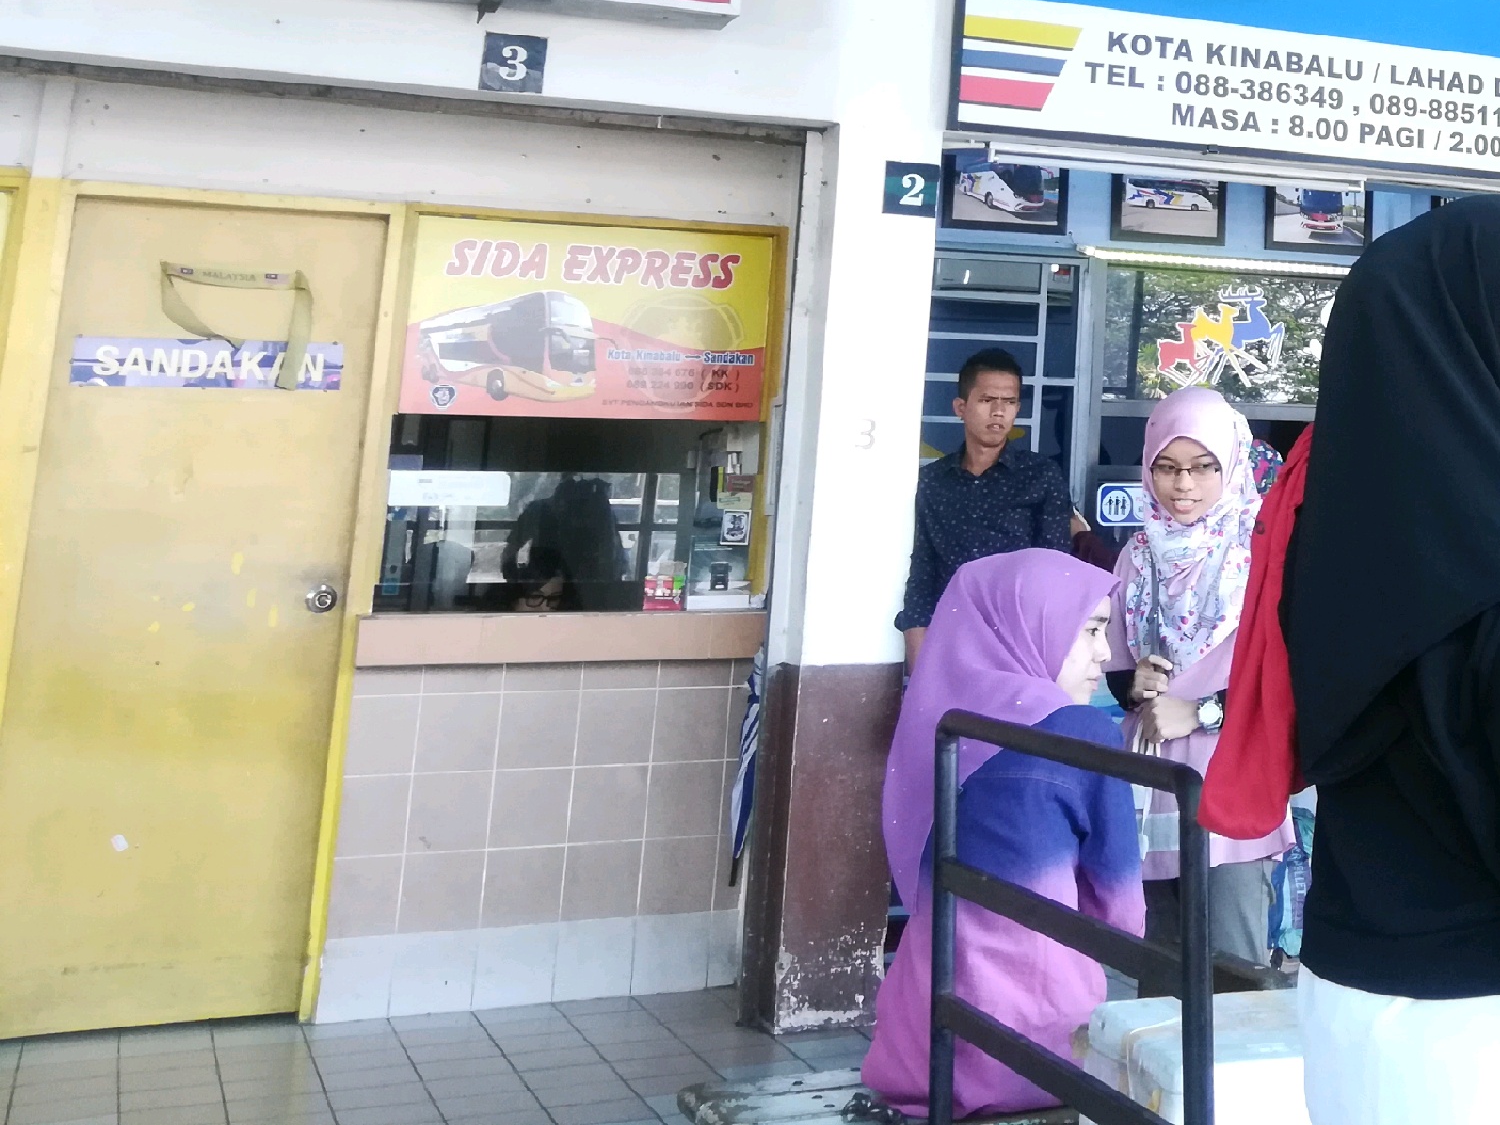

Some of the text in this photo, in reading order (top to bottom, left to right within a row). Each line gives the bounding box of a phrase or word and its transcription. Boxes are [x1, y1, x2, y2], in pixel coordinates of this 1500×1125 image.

[498, 45, 528, 81] 3
[1106, 31, 1194, 63] KOTA
[1206, 36, 1364, 82] KINABALU
[1373, 62, 1381, 83] /
[1391, 64, 1485, 96] LAHAD
[1085, 61, 1145, 90] TEL
[1175, 70, 1343, 111] 088-386349
[1172, 102, 1261, 134] MASA
[1288, 114, 1348, 142] 8.00
[1359, 124, 1425, 149] PAGI
[1434, 129, 1441, 150] /
[899, 173, 926, 207] 2
[446, 239, 741, 290] SIDA EXPRESS
[703, 351, 754, 365] Sandakan
[708, 381, 732, 391] SDK
